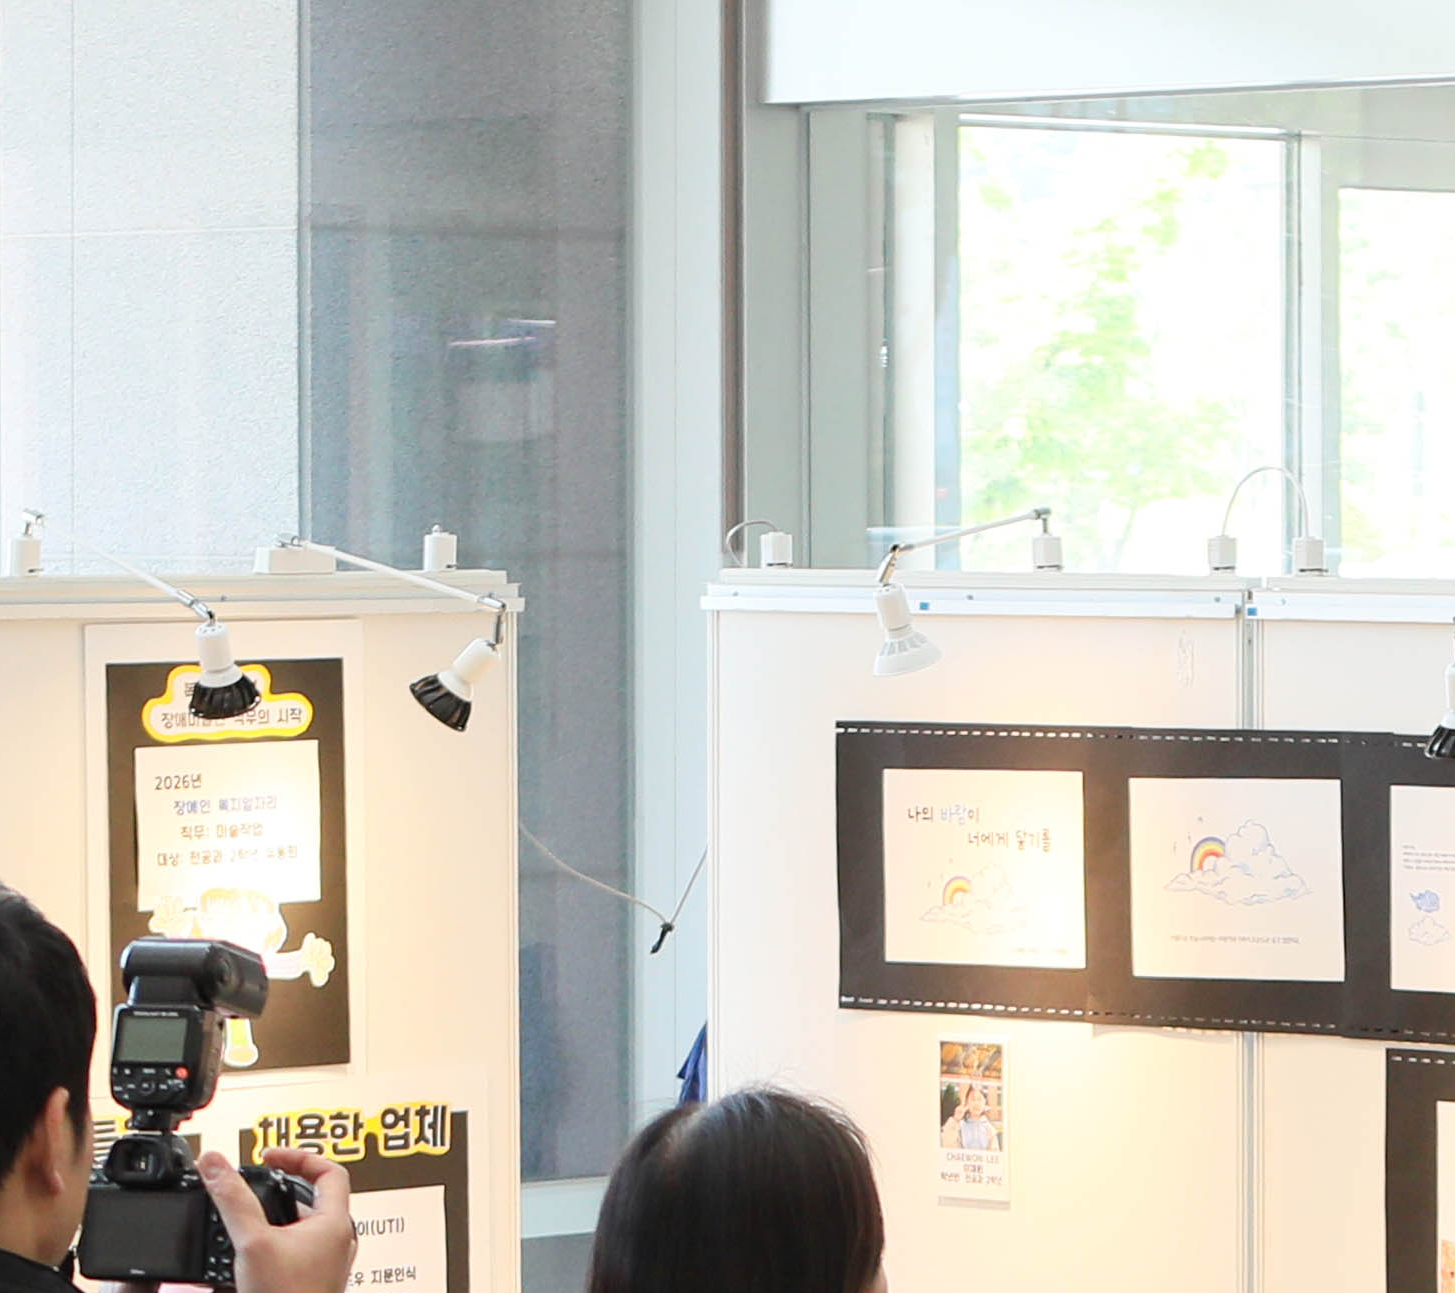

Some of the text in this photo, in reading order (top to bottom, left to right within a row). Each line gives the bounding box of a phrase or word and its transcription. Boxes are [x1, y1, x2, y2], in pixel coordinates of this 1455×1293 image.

[276, 706, 303, 724] 시작
[154, 772, 202, 791] 2026년
[907, 805, 934, 824] 나의
[968, 830, 1009, 848] 너에게
[258, 1105, 447, 1156] 채용한 업체
[356, 1216, 405, 1236] 이(UTI)
[370, 1266, 416, 1285] 지문인식
